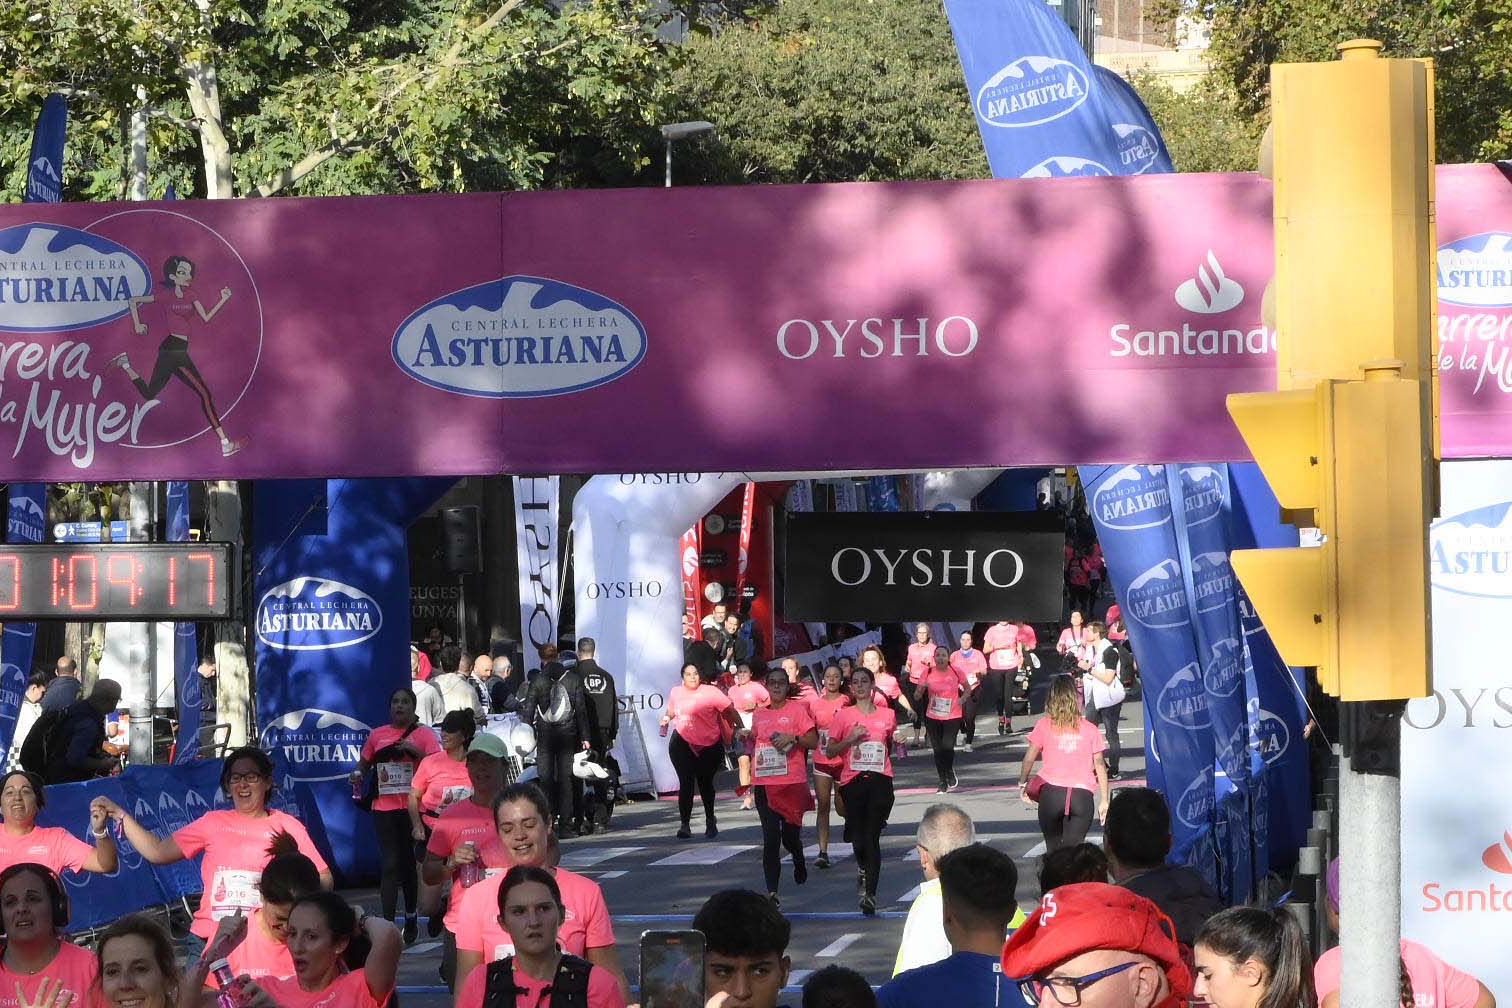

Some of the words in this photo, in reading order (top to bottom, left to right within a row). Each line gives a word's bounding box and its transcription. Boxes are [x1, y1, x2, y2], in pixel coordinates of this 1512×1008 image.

[54, 259, 126, 271] LECHERA
[451, 318, 530, 331] CENTRAL
[536, 317, 619, 330] LECHERA
[776, 315, 979, 360] OYSHO
[1438, 312, 1512, 342] arrer
[412, 323, 627, 367] ASTURIANA
[1460, 343, 1478, 371] la
[13, 375, 161, 468] Mujer
[620, 473, 702, 485] OYSHO
[831, 547, 1024, 588] OYSHO
[587, 581, 662, 599] OYSHO
[261, 606, 374, 633] ASTURIANA
[273, 603, 315, 611] CENTRAL
[320, 601, 368, 609] LECHERA
[619, 693, 664, 711] SHO
